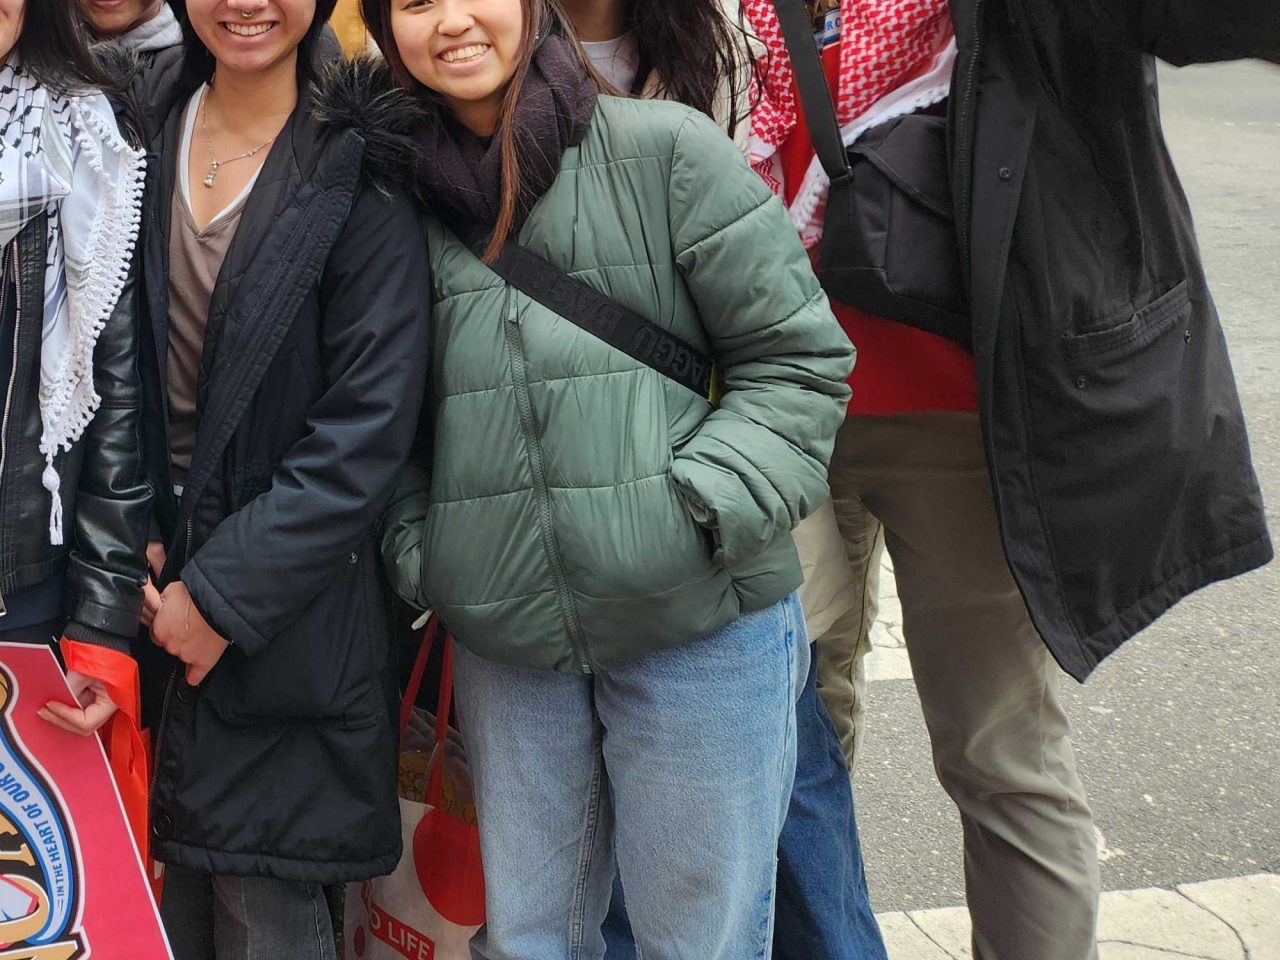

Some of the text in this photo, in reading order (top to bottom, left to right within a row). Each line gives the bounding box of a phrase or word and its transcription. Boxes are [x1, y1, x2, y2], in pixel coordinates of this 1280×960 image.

[627, 324, 708, 393] AGGU
[25, 802, 43, 821] OF
[33, 820, 61, 862] HEART
[52, 862, 64, 885] THE
[57, 885, 65, 897] IN
[387, 921, 431, 960] LIFE
